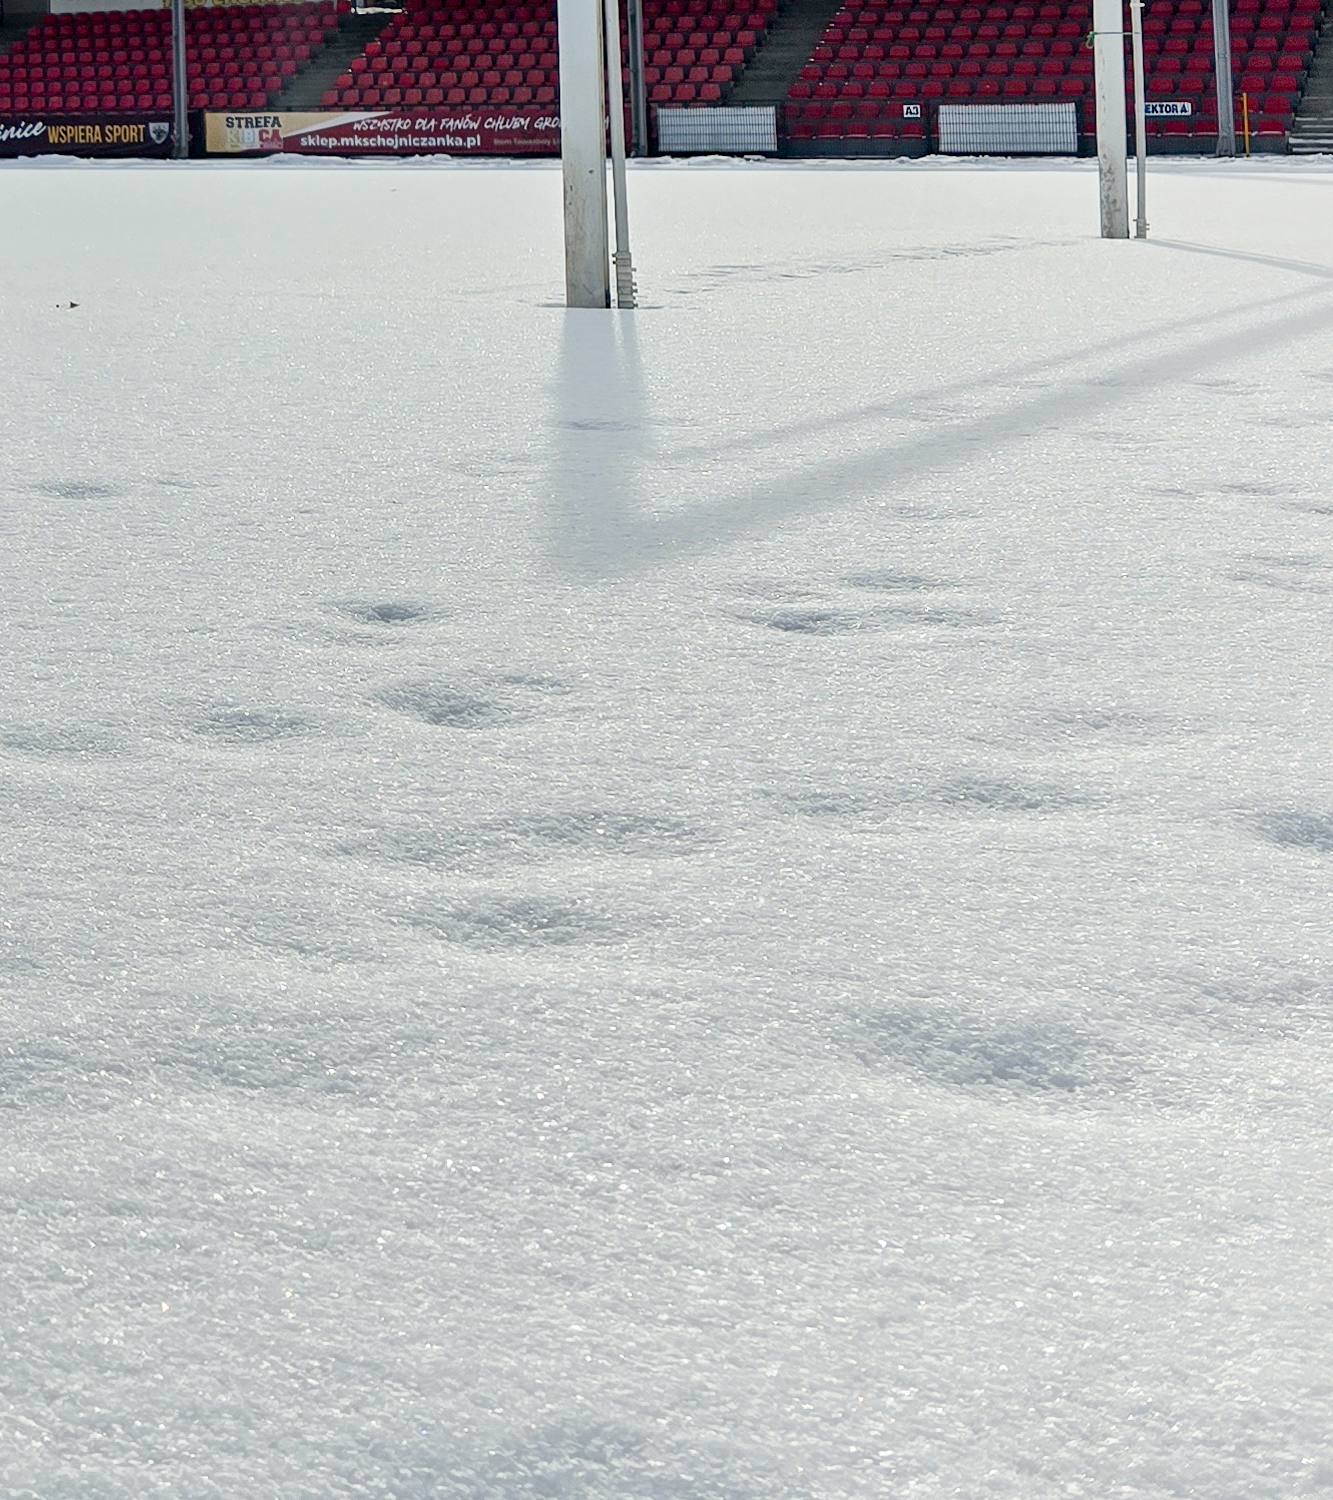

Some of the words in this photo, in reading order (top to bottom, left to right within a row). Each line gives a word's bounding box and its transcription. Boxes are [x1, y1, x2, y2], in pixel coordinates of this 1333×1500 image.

[905, 106, 919, 115] A3
[1145, 104, 1179, 113] EKTOR
[225, 116, 282, 128] STREFA
[47, 125, 101, 144] WSPIERA
[105, 124, 146, 143] SPORT
